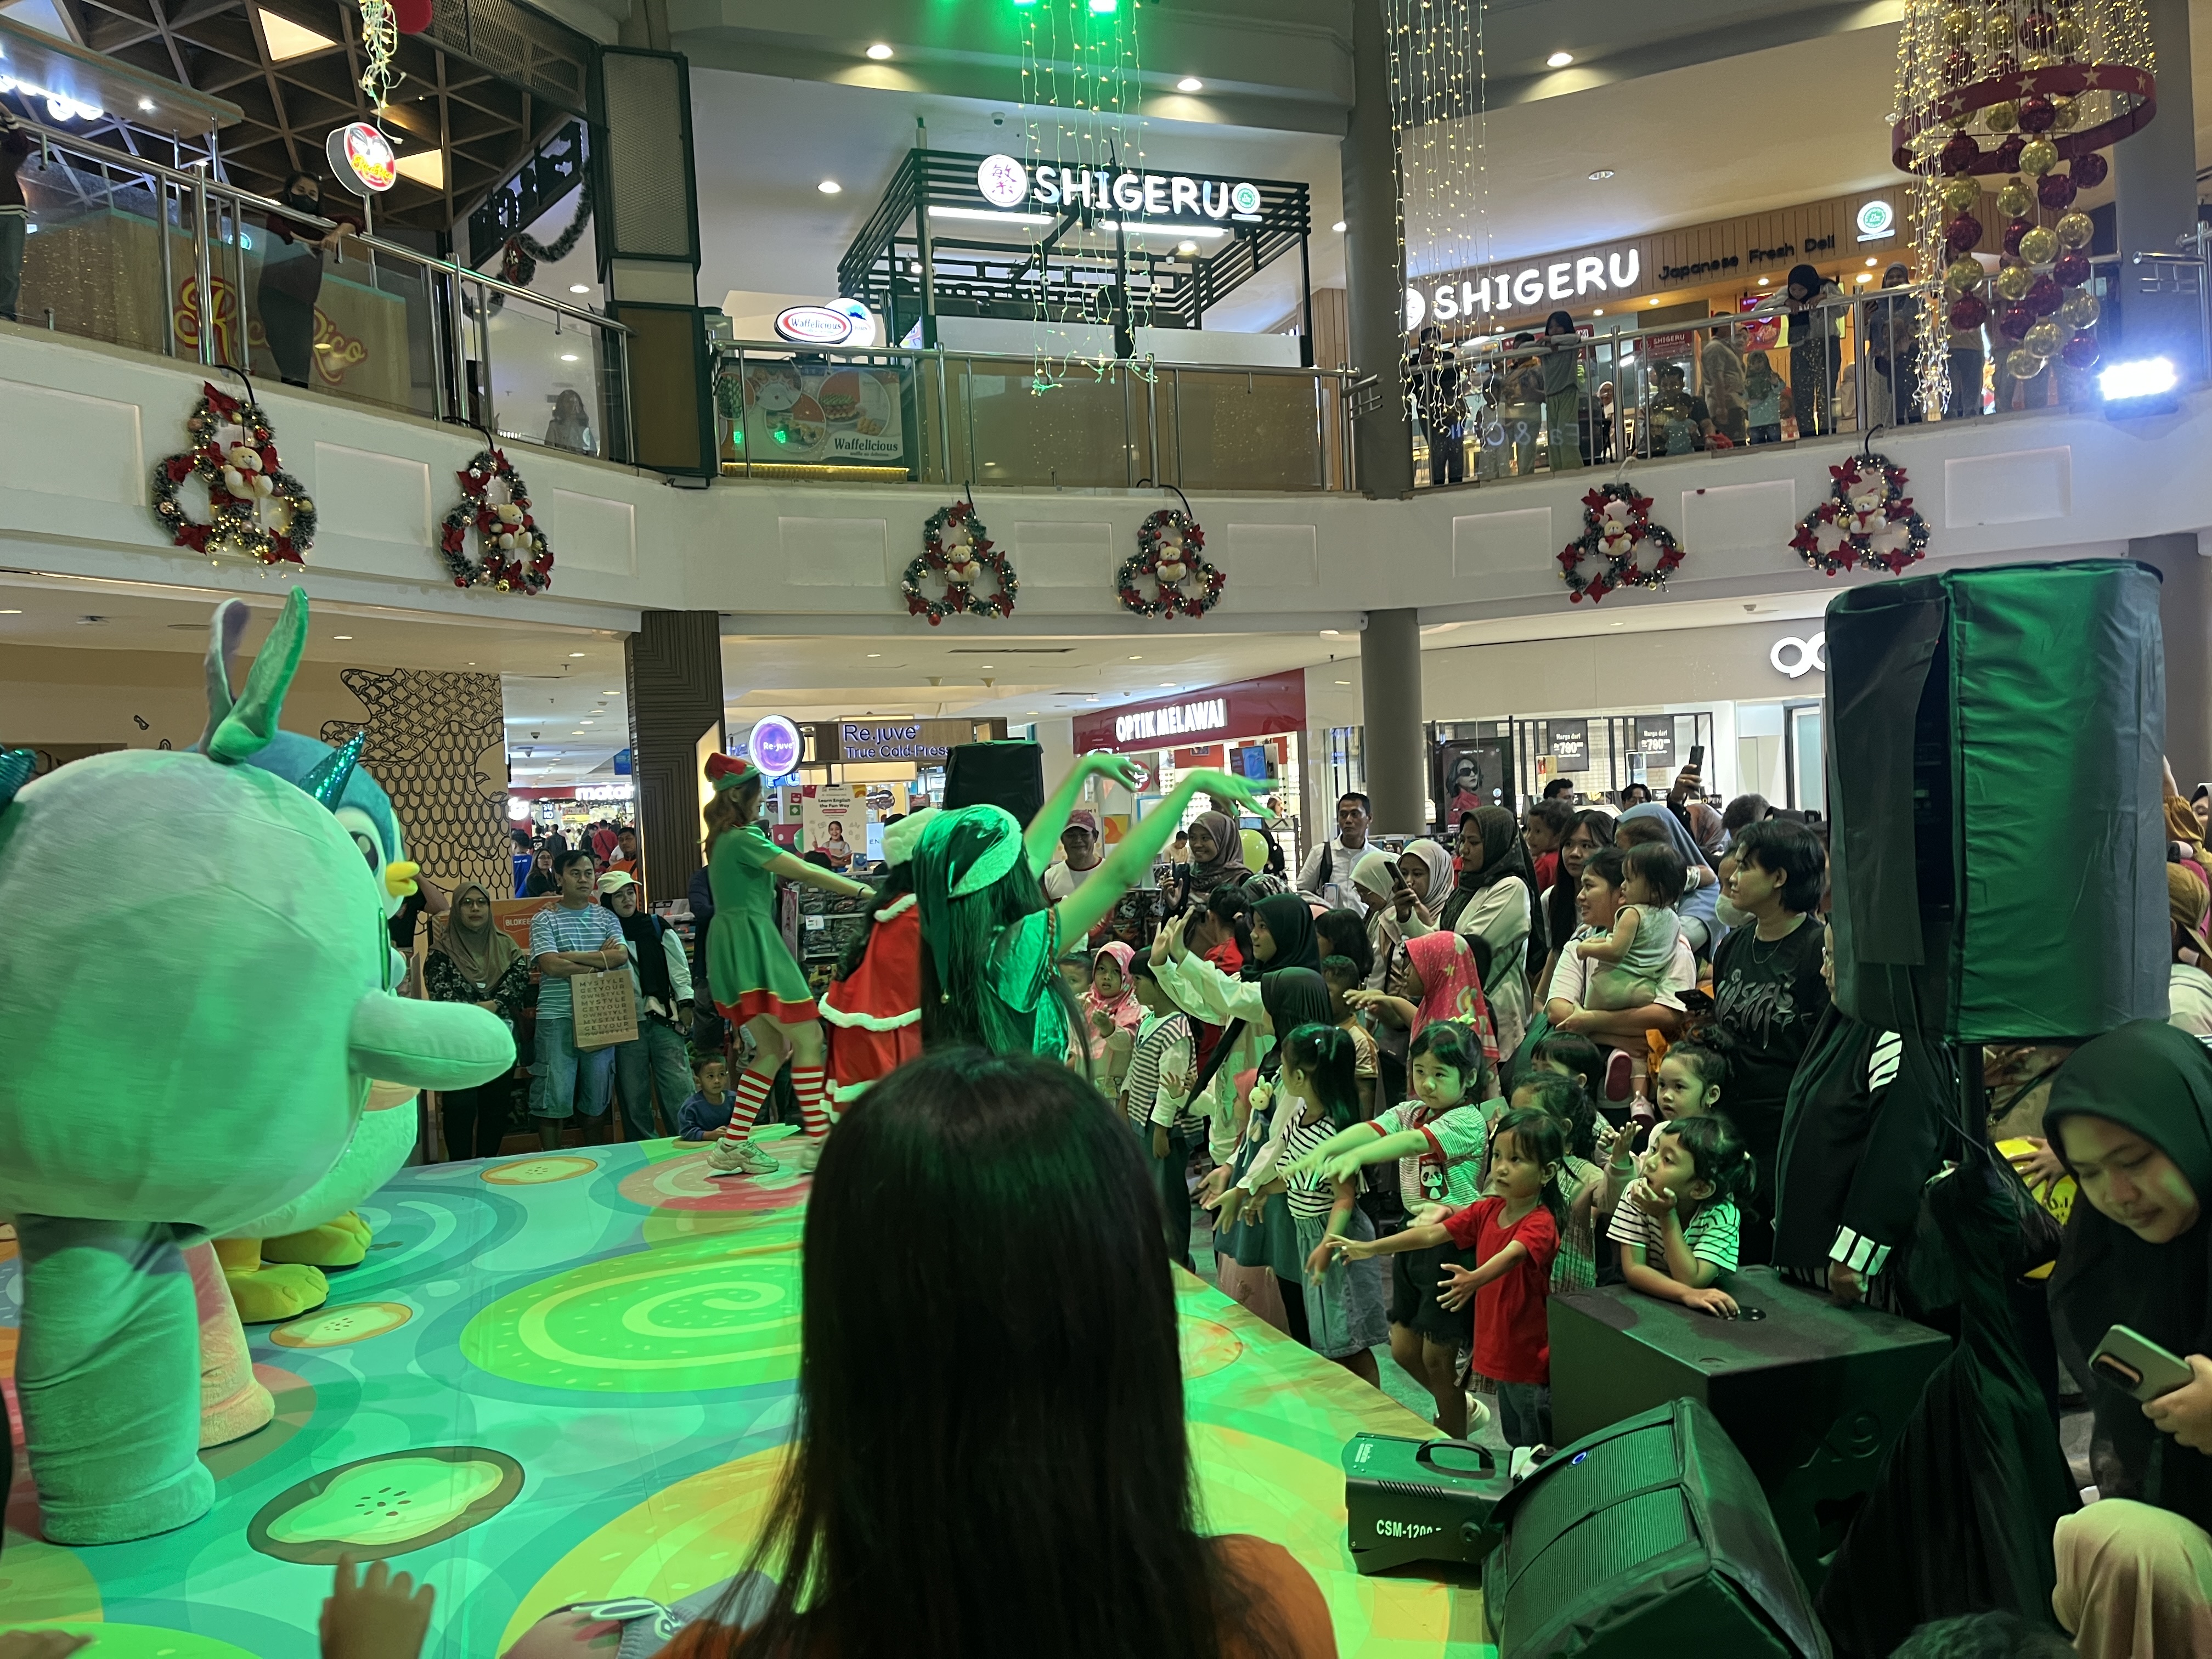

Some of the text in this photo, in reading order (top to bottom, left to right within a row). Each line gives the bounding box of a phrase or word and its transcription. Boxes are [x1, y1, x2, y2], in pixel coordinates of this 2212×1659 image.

[1033, 166, 1229, 218] SHIGERU
[1658, 256, 1739, 281] Japanese
[1748, 242, 1795, 264] Fresh
[1433, 249, 1640, 320] SHIGERU
[791, 318, 842, 330] Waffelicious
[1653, 334, 1685, 345] SHIGERU
[834, 438, 898, 452] Waffelicious
[1115, 698, 1226, 742] OPTIK MELAWAI
[844, 746, 876, 758] True
